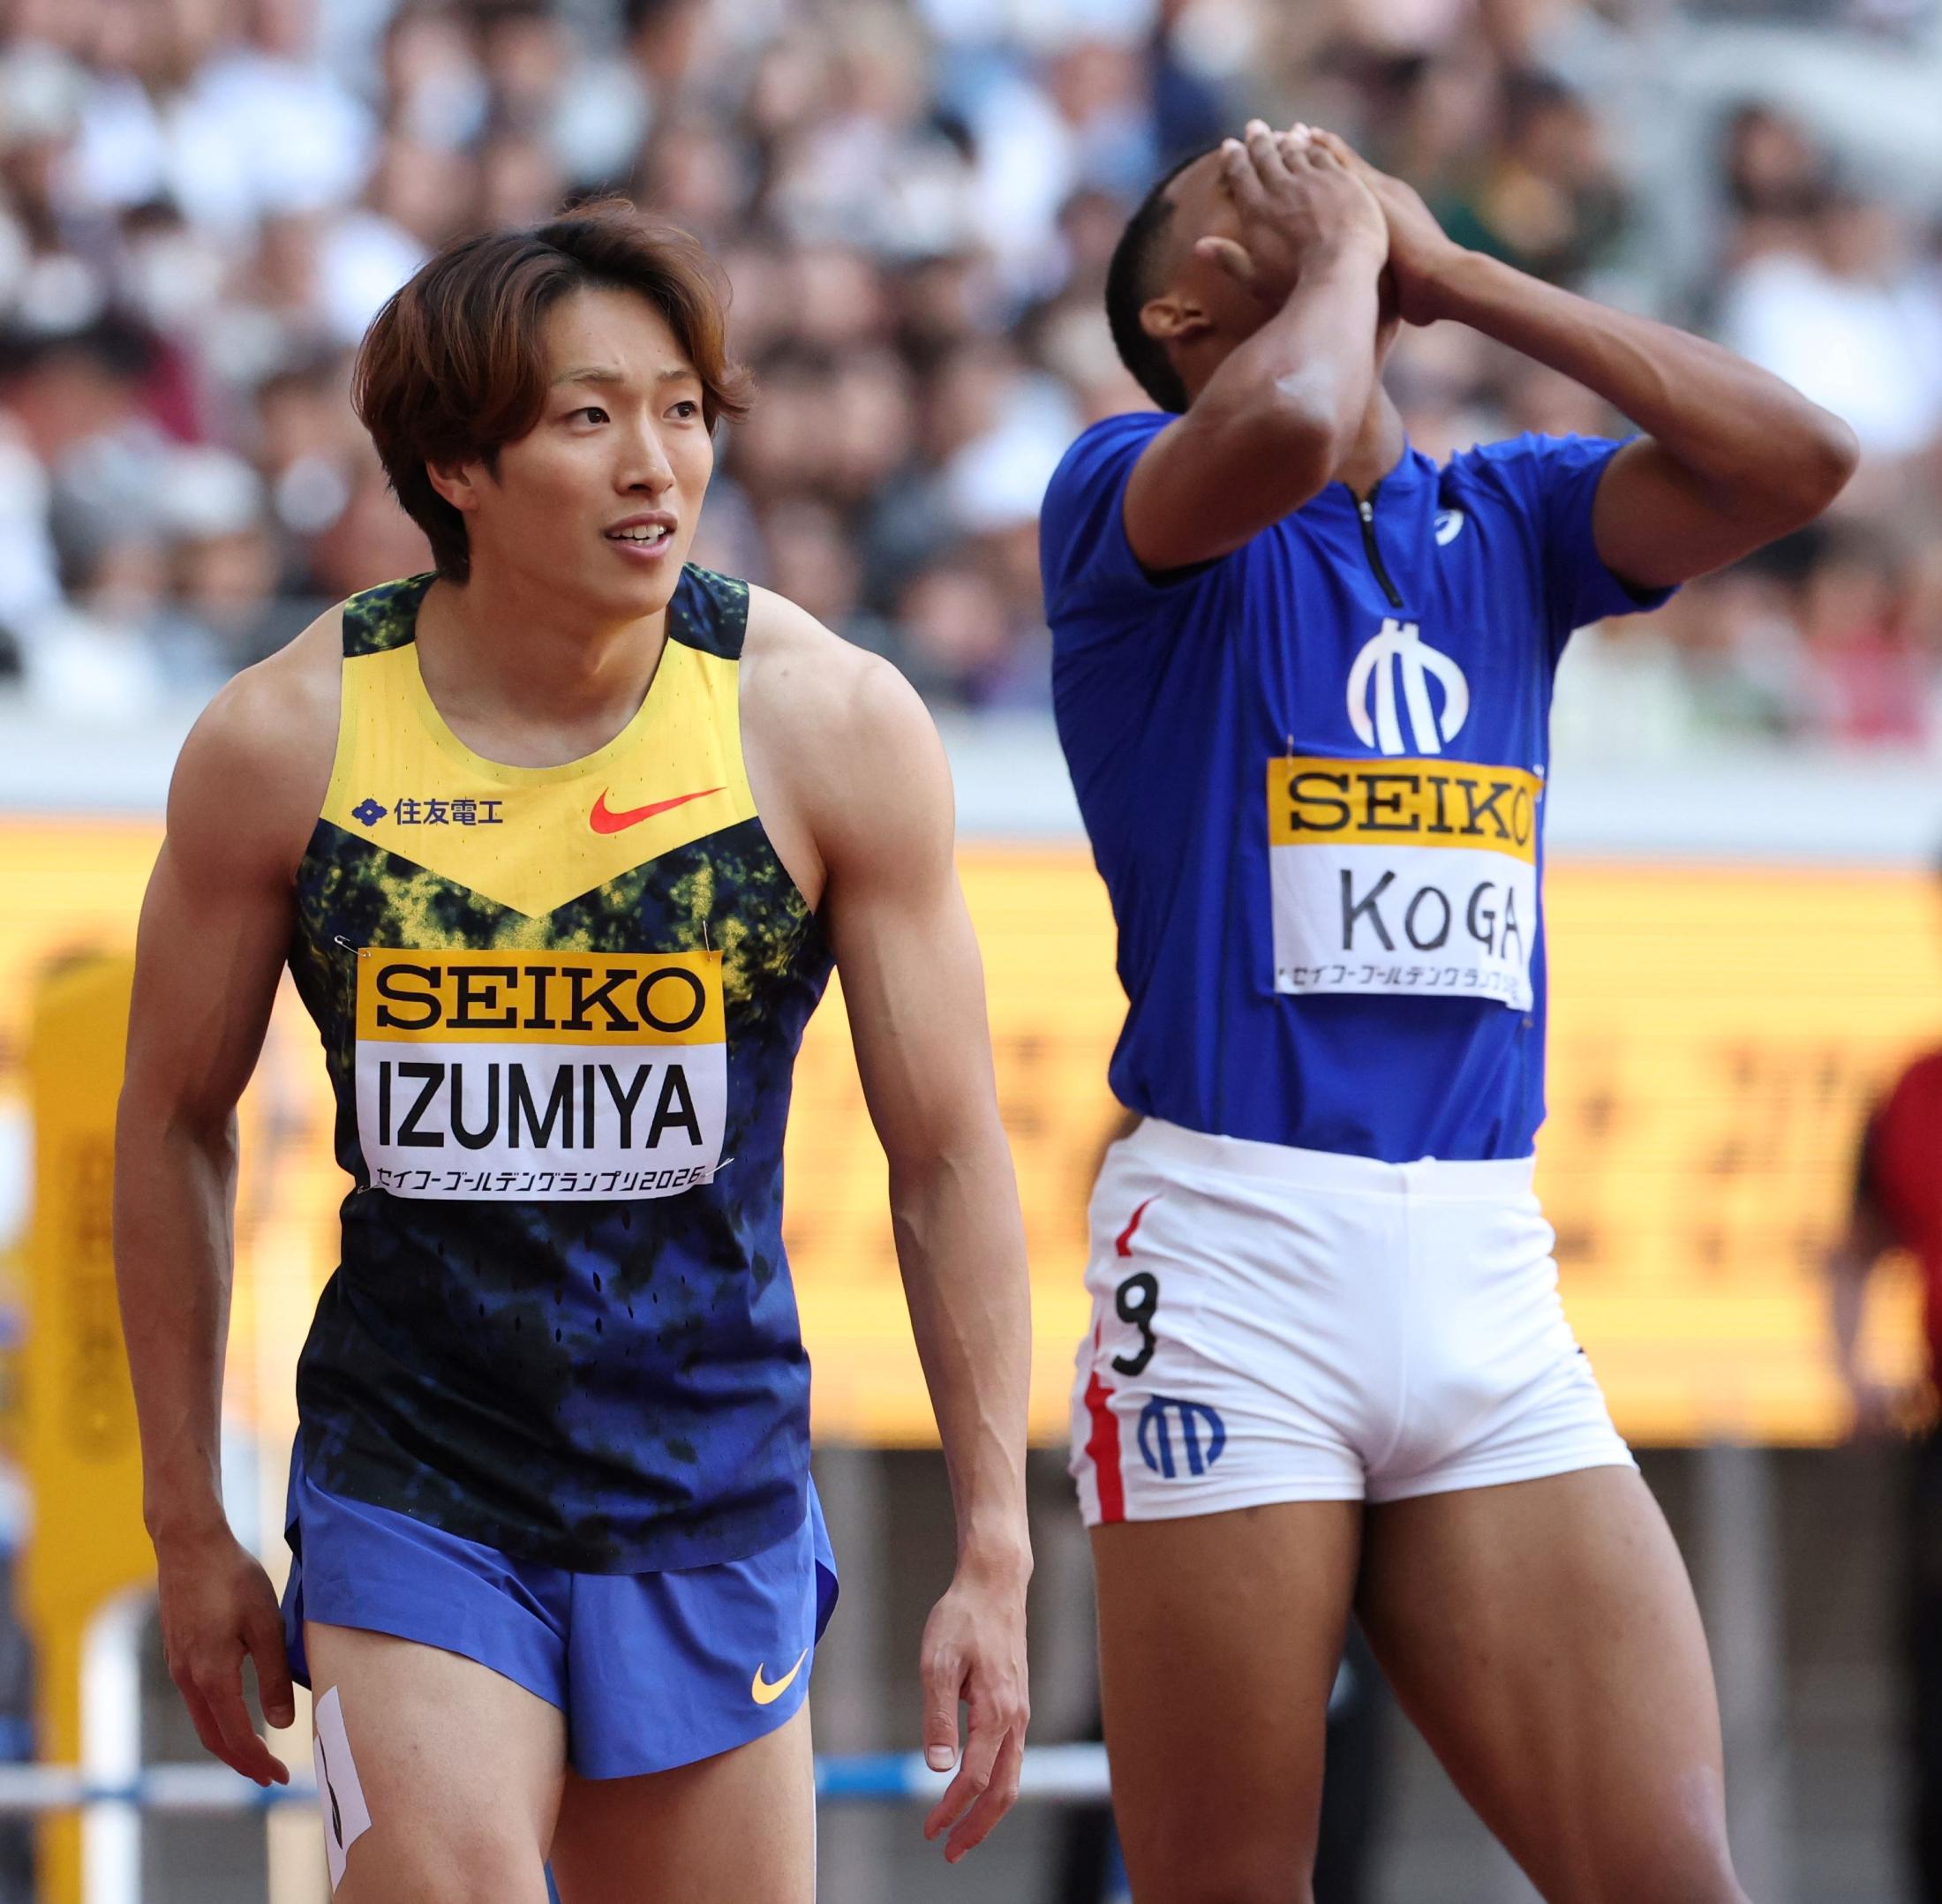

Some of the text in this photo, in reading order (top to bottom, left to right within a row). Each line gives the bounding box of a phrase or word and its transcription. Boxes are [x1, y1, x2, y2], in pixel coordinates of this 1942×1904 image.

[394, 798, 503, 826] 住友電工
[1288, 771, 1532, 847] SEIKO
[1340, 869, 1524, 964] KOGA
[376, 964, 706, 1033] SEIKO
[379, 1060, 704, 1150] IZUMIYA
[376, 1165, 706, 1192] セイコーゴールデングランプリ2026
[1111, 1271, 1159, 1377] 9
